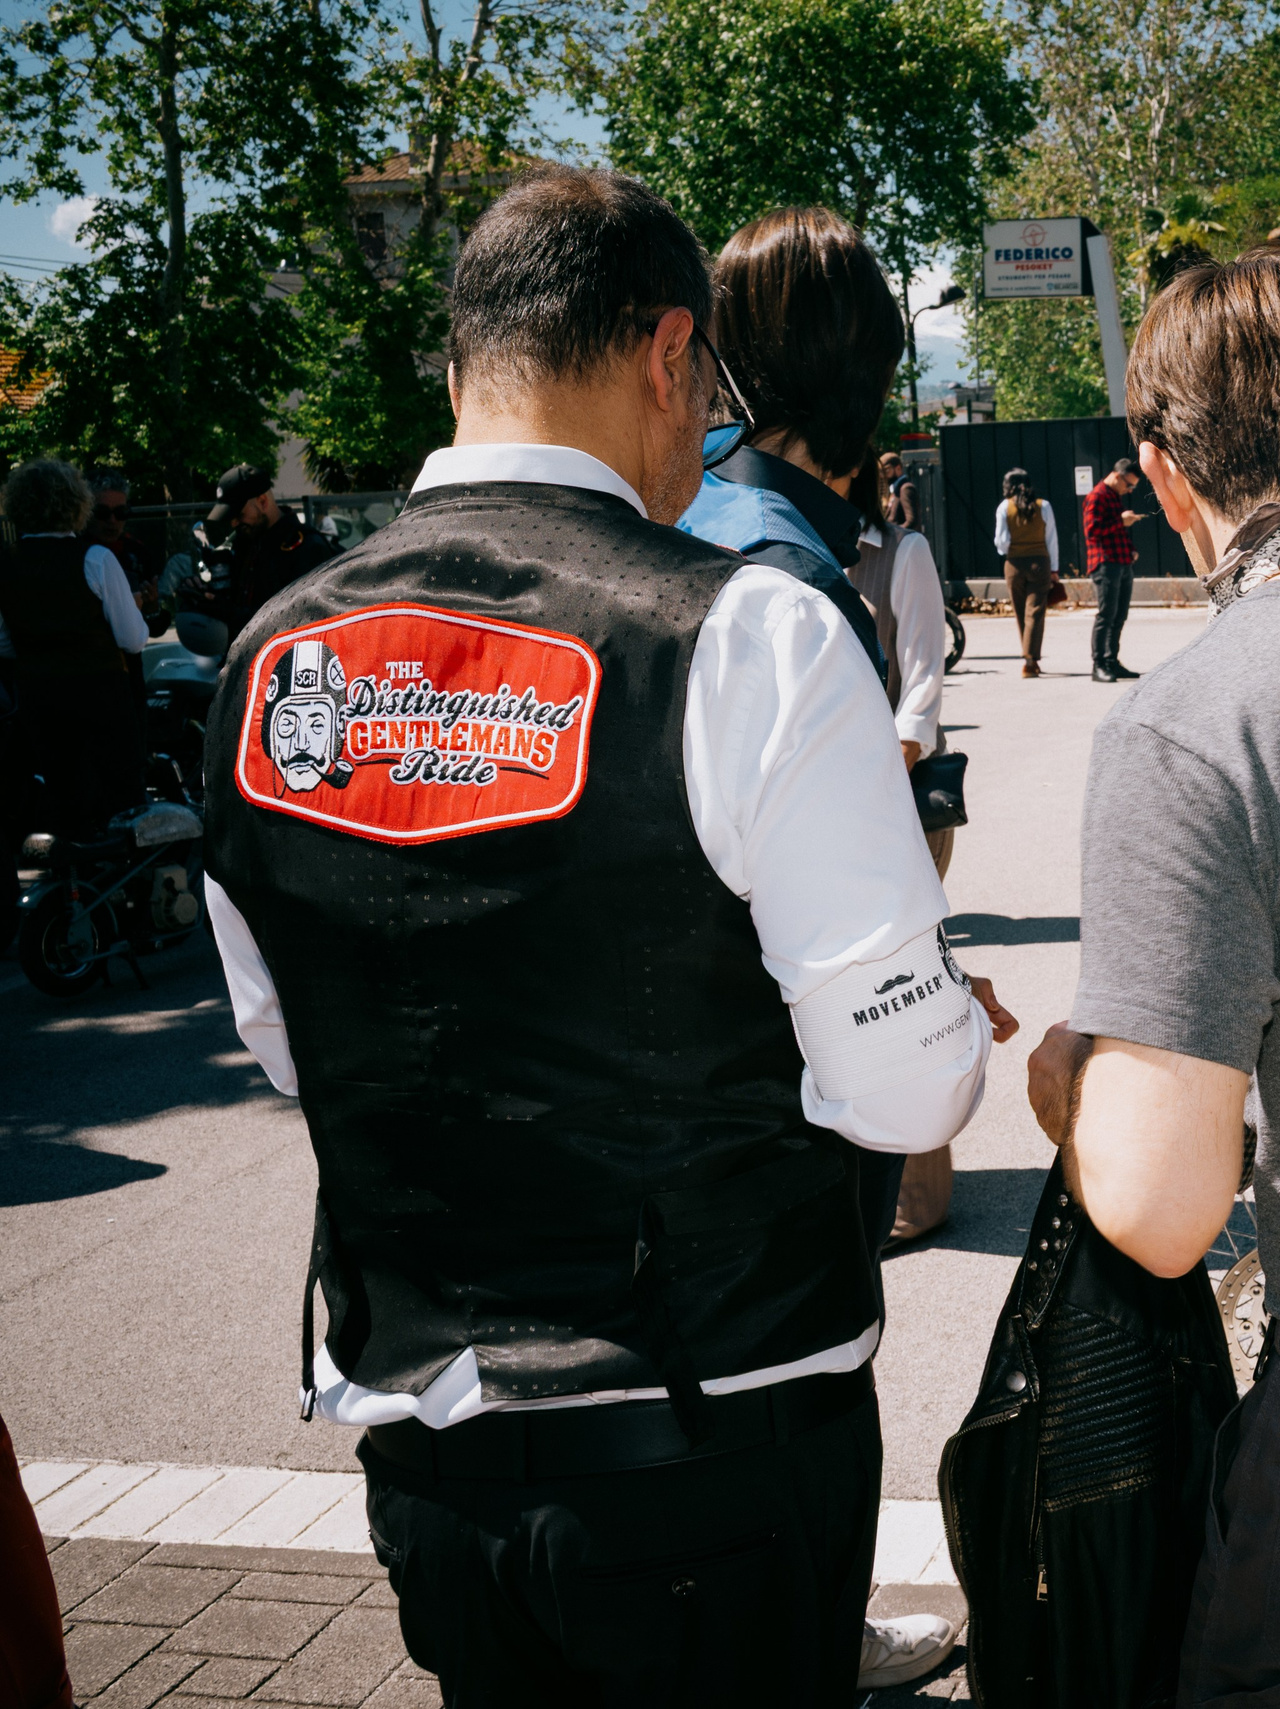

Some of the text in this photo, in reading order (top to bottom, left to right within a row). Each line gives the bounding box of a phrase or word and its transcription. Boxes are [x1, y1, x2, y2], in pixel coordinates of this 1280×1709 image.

[994, 247, 1074, 262] FEDERICO
[296, 671, 317, 686] SCR
[386, 661, 424, 680] THE
[347, 675, 584, 731] Distinguished
[348, 718, 559, 771] GENTLEMANS
[390, 747, 497, 786] Ride
